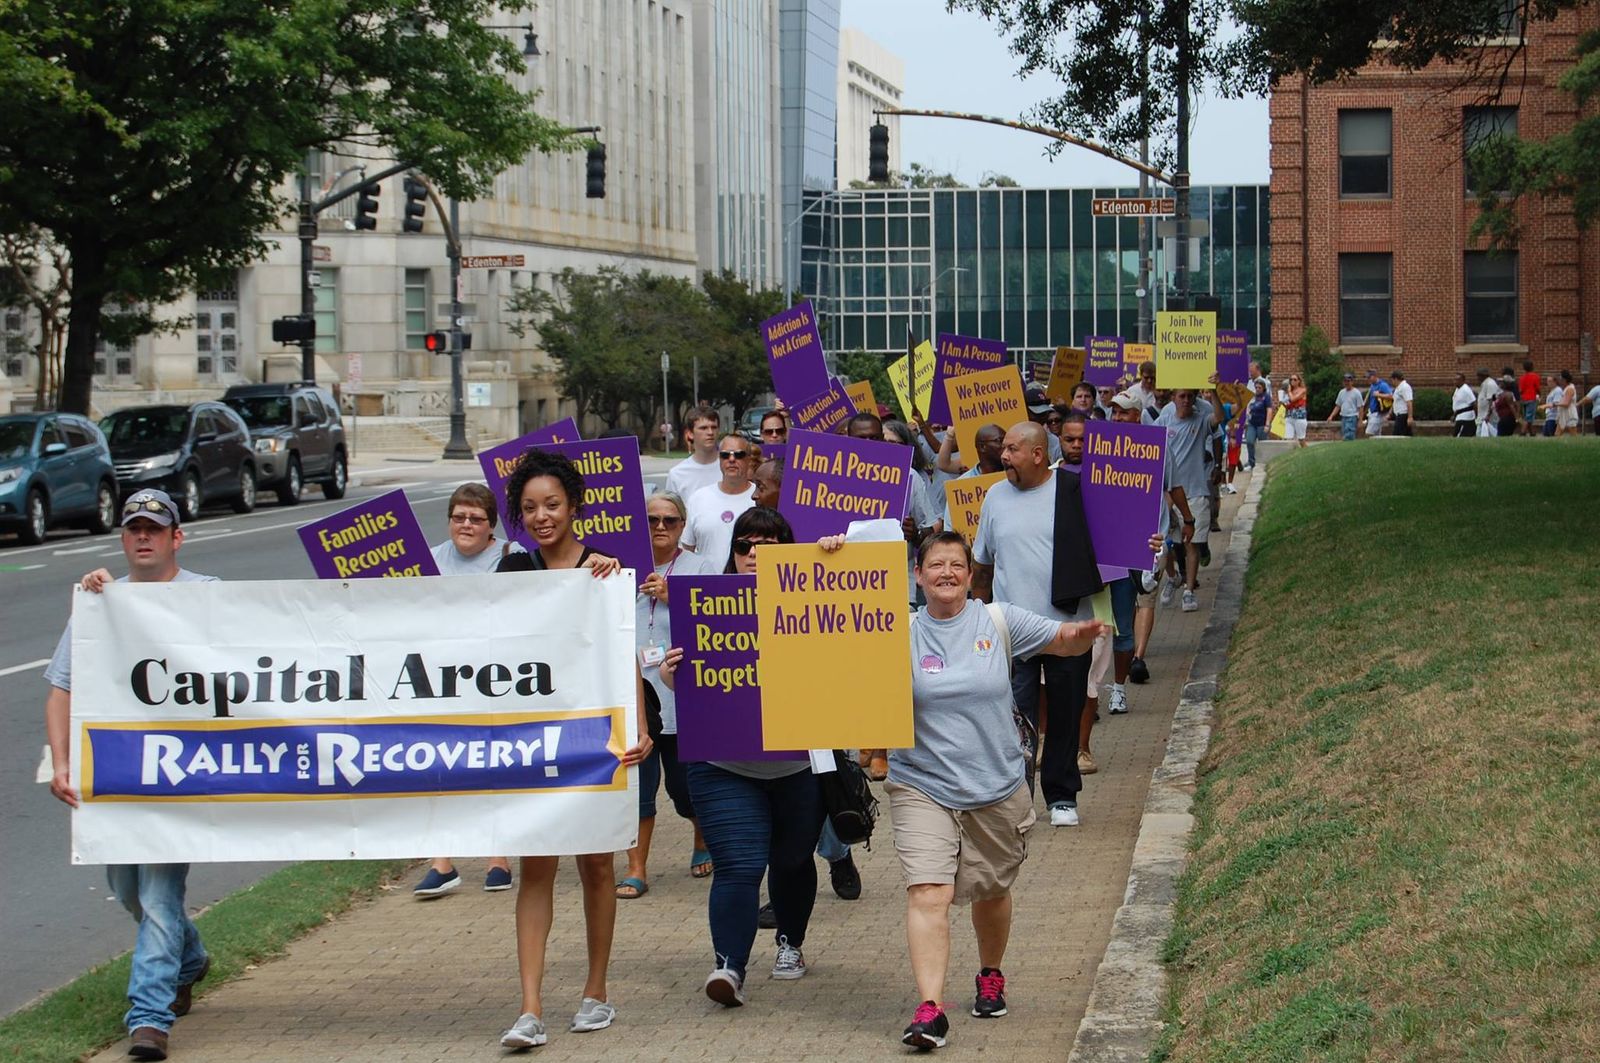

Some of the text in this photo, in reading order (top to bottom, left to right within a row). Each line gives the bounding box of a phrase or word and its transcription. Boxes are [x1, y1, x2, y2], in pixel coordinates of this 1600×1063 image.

[1101, 201, 1146, 214] Edenton
[767, 311, 809, 342] Addiction Is
[1170, 315, 1204, 327] Join The
[771, 332, 813, 360] Not A Crime
[1090, 339, 1119, 349] Families
[1161, 331, 1172, 344] NC
[1174, 331, 1211, 346] Recovery
[1217, 346, 1243, 356] Recovery
[1225, 335, 1246, 344] Person
[941, 340, 1002, 363] I Am A Person
[1090, 358, 1119, 369] Together
[1091, 348, 1117, 358] Recover
[1164, 349, 1208, 361] Movement
[898, 360, 909, 373] Joi
[943, 360, 952, 375] In
[897, 377, 907, 391] NC
[955, 378, 1012, 400] We Recover
[797, 388, 840, 425] Addiction Is
[820, 417, 829, 430] A
[825, 405, 849, 426] Crime
[958, 396, 1018, 421] And We Vote
[1087, 432, 1160, 461] I Am A Person
[792, 443, 901, 486] I Am A Person
[1091, 462, 1153, 494] In Recovery
[794, 479, 890, 520] In Recovery
[952, 488, 974, 506] The
[318, 510, 398, 552] Families
[572, 511, 632, 541] gether
[332, 538, 407, 578] Recover
[776, 562, 889, 593] We Recover
[773, 602, 895, 635] And We Vote
[130, 653, 557, 718] Capital Area
[141, 733, 289, 787] RALLY
[296, 743, 311, 780] FOR
